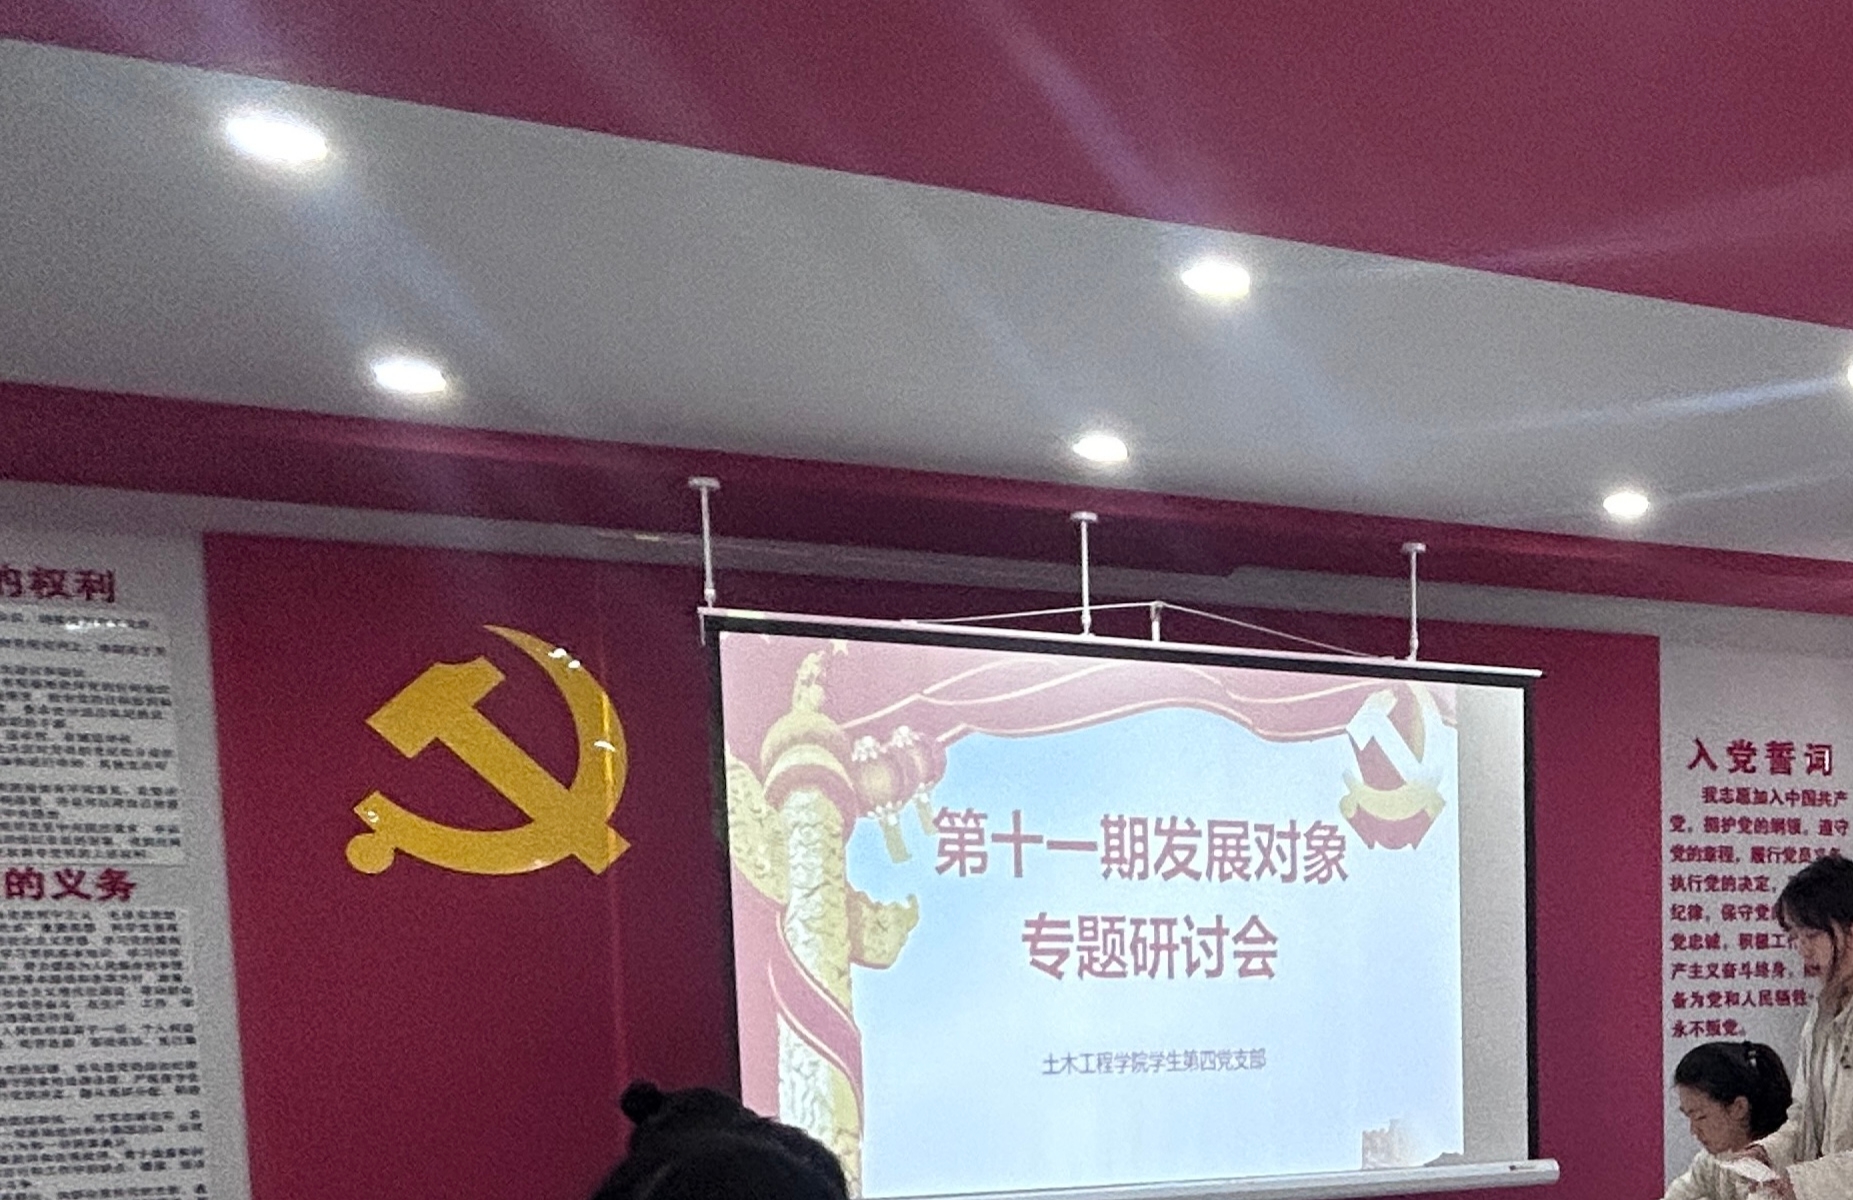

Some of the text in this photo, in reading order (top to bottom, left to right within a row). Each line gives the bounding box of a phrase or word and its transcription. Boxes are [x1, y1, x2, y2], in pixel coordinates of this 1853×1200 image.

[1687, 738, 1832, 776] 入党誓词
[1702, 786, 1848, 807] 我志愿加入中国共产
[933, 807, 1347, 884] 第十一期发展对象
[4, 867, 137, 900] 的义务
[1022, 911, 1278, 982] 专题研讨会
[1042, 1048, 1266, 1075] 土木工程学院学生第四党支部
